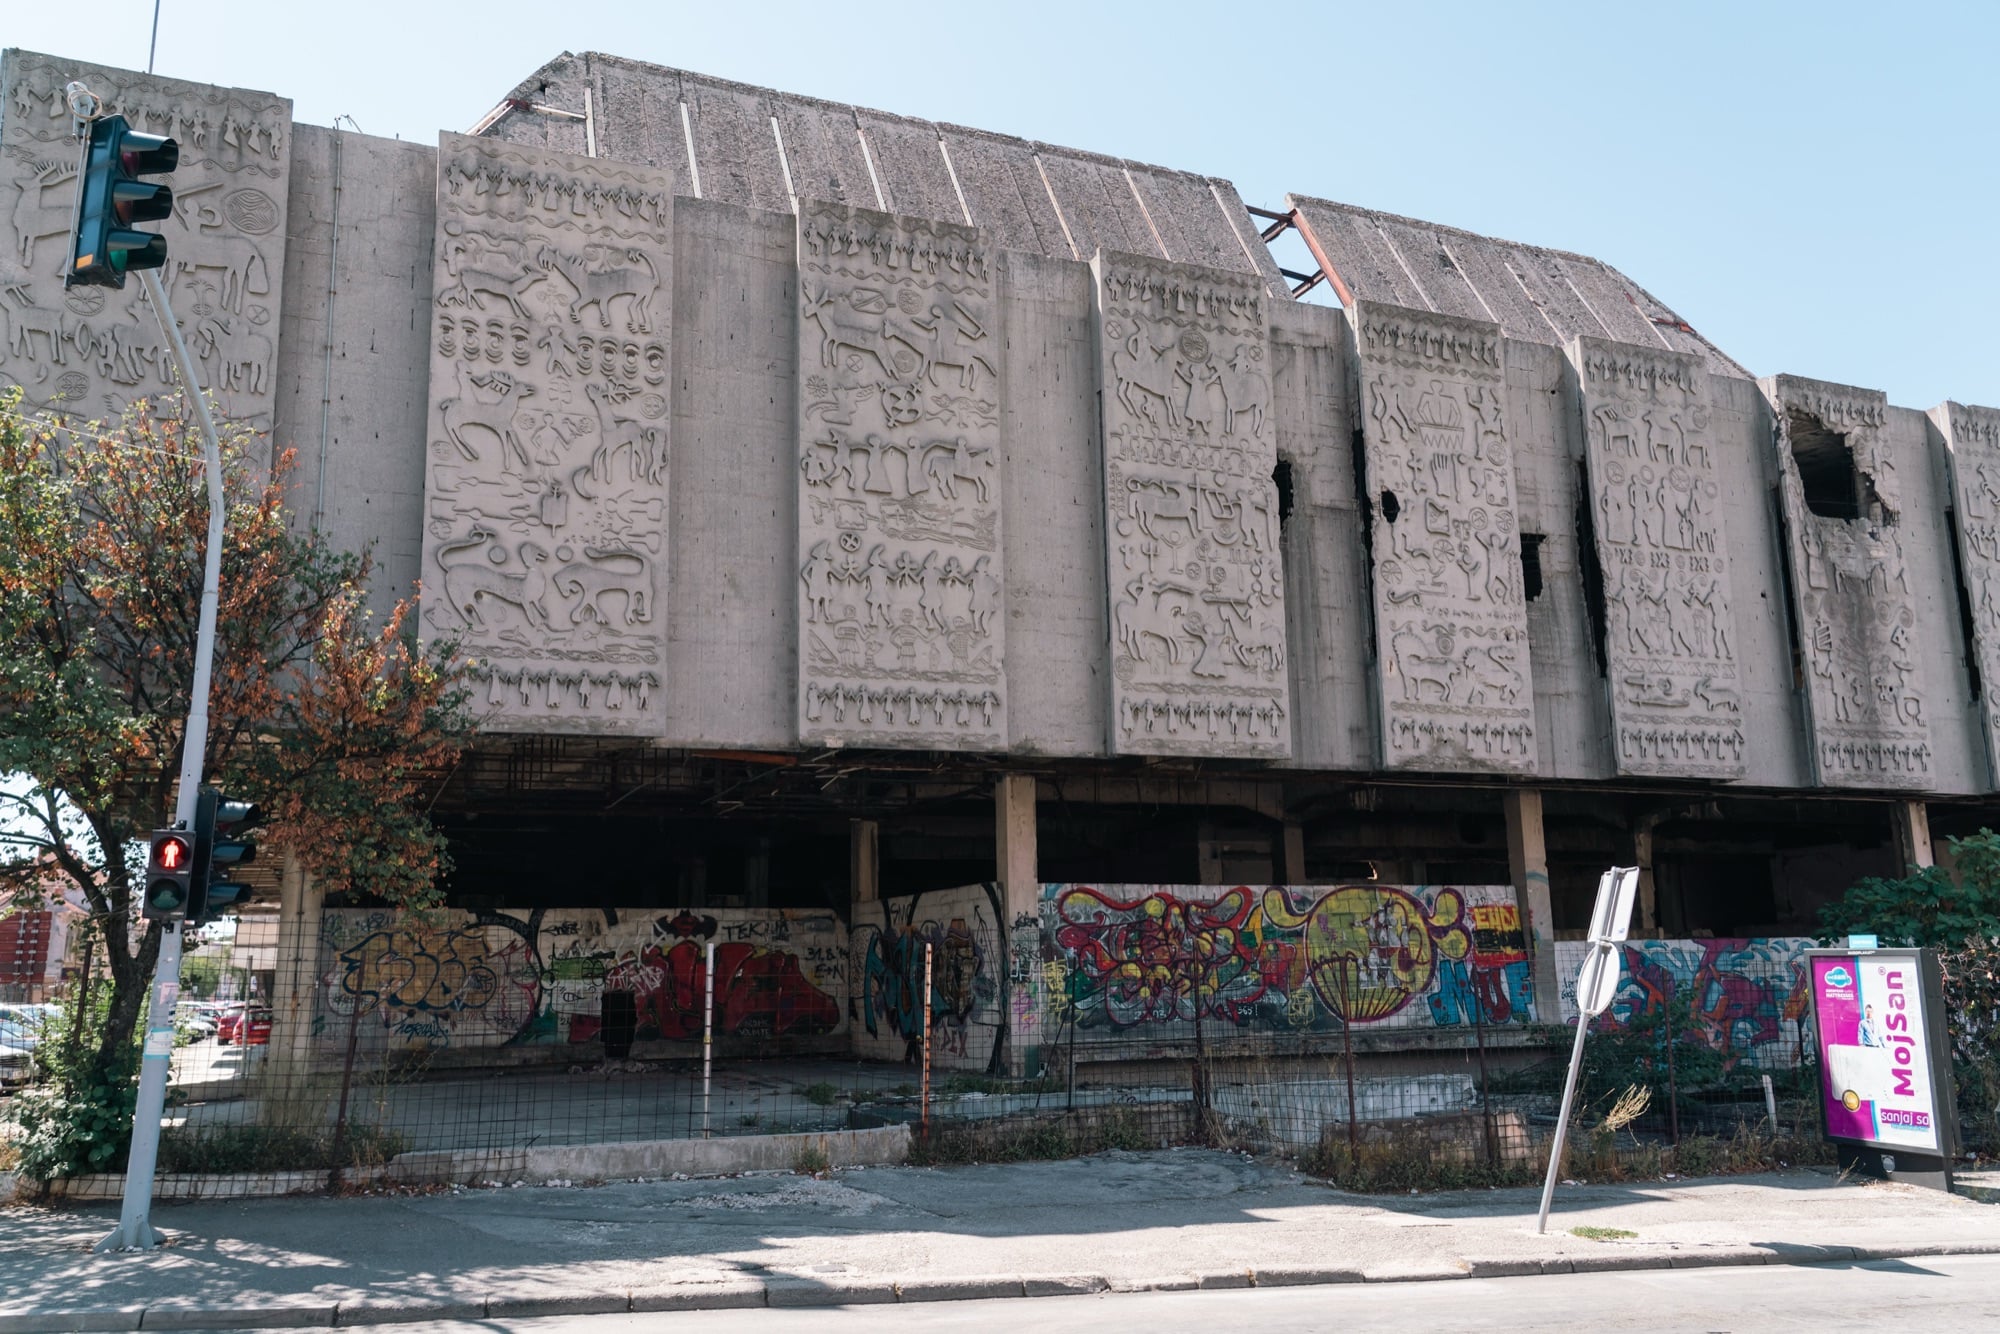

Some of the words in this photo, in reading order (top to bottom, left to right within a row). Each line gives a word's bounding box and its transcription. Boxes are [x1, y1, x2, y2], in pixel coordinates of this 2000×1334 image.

[1886, 971, 1915, 1097] MojSan
[1881, 1111, 1913, 1126] sanjaj
[1916, 1115, 1929, 1126] sa
